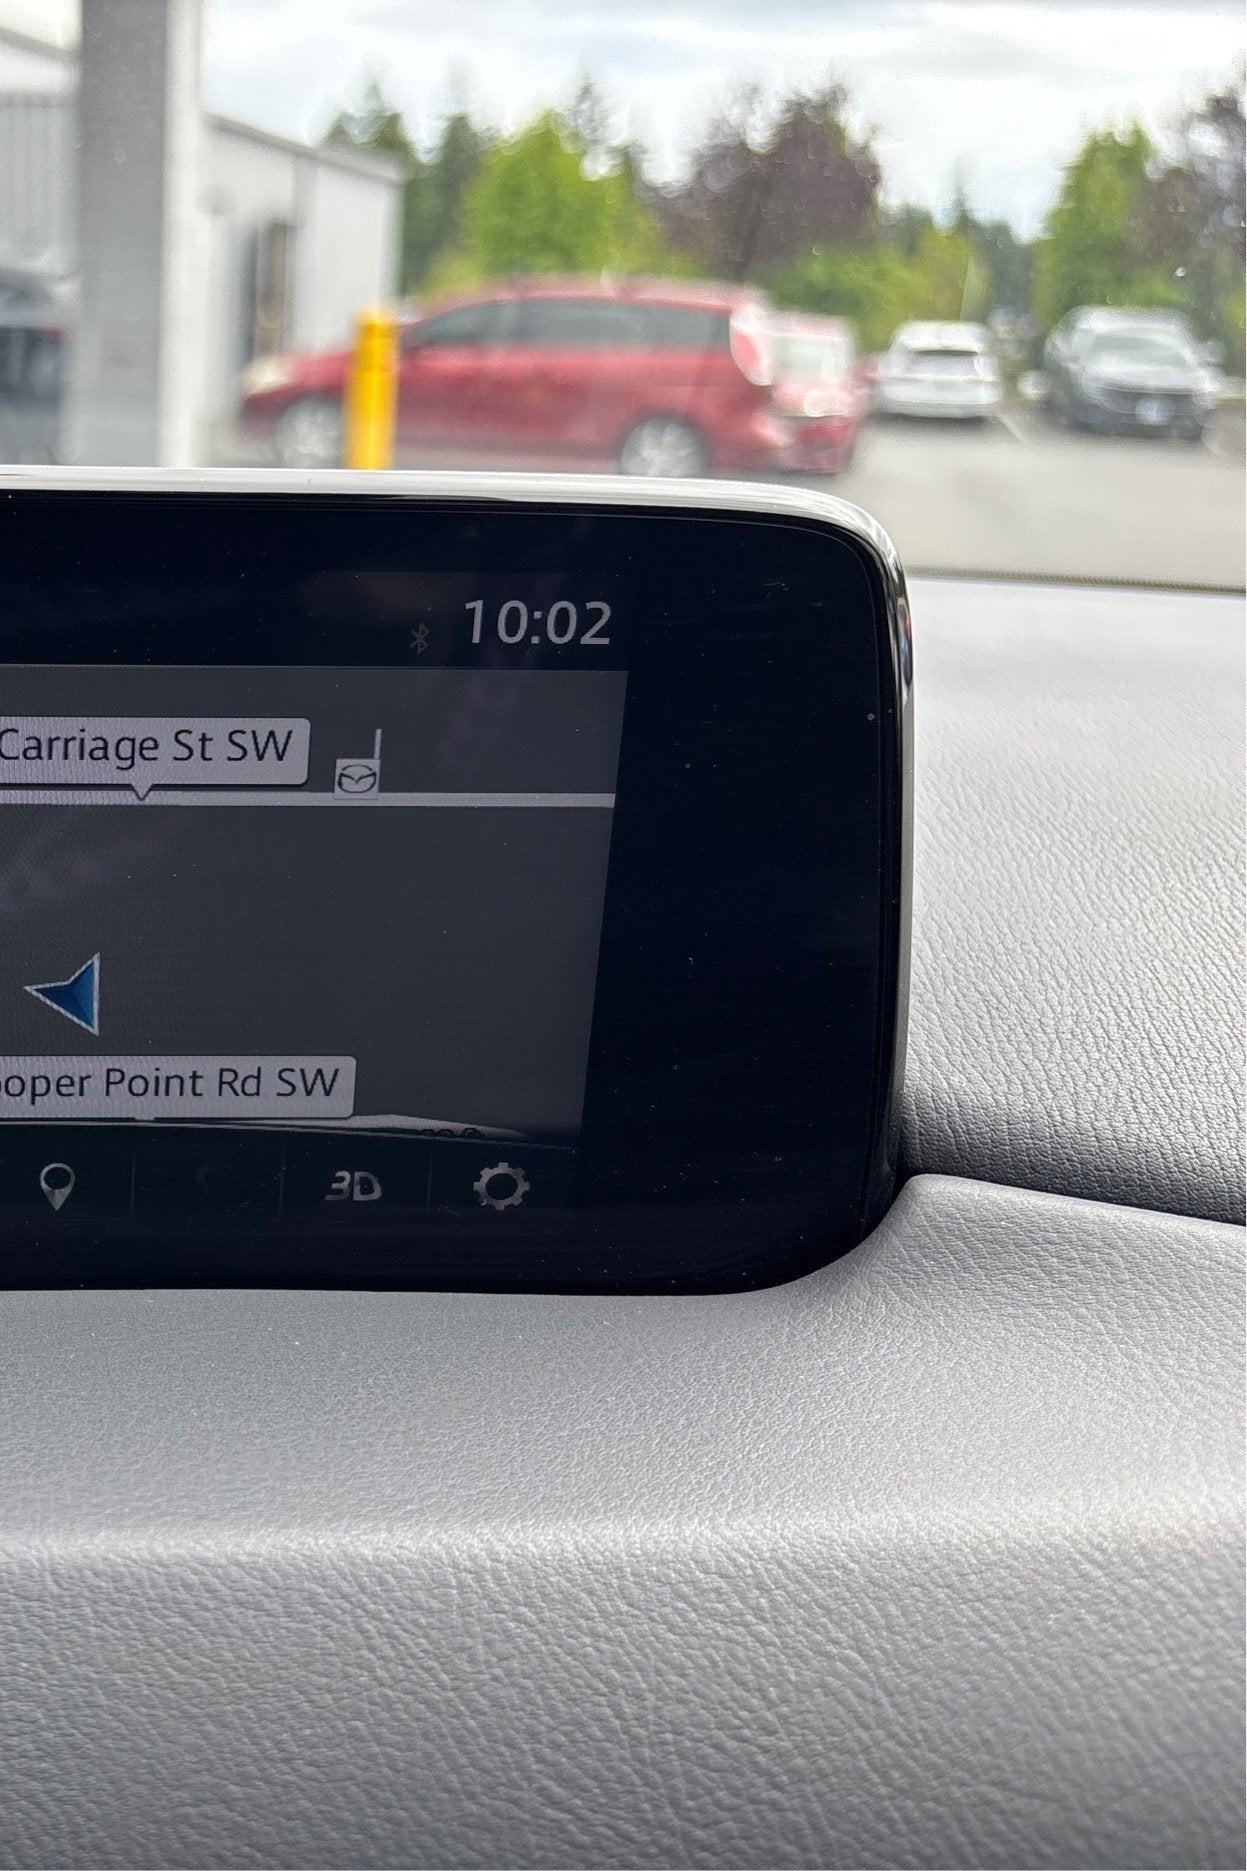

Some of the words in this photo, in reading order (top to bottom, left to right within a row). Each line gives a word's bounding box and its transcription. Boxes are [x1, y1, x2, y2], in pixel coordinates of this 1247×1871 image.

[465, 600, 612, 645] 10:02
[173, 729, 213, 762] St
[227, 729, 294, 762] SW
[105, 1067, 203, 1098] Point
[218, 1065, 262, 1098] Rd
[276, 1067, 340, 1098] SW
[324, 1171, 383, 1201] 3D
